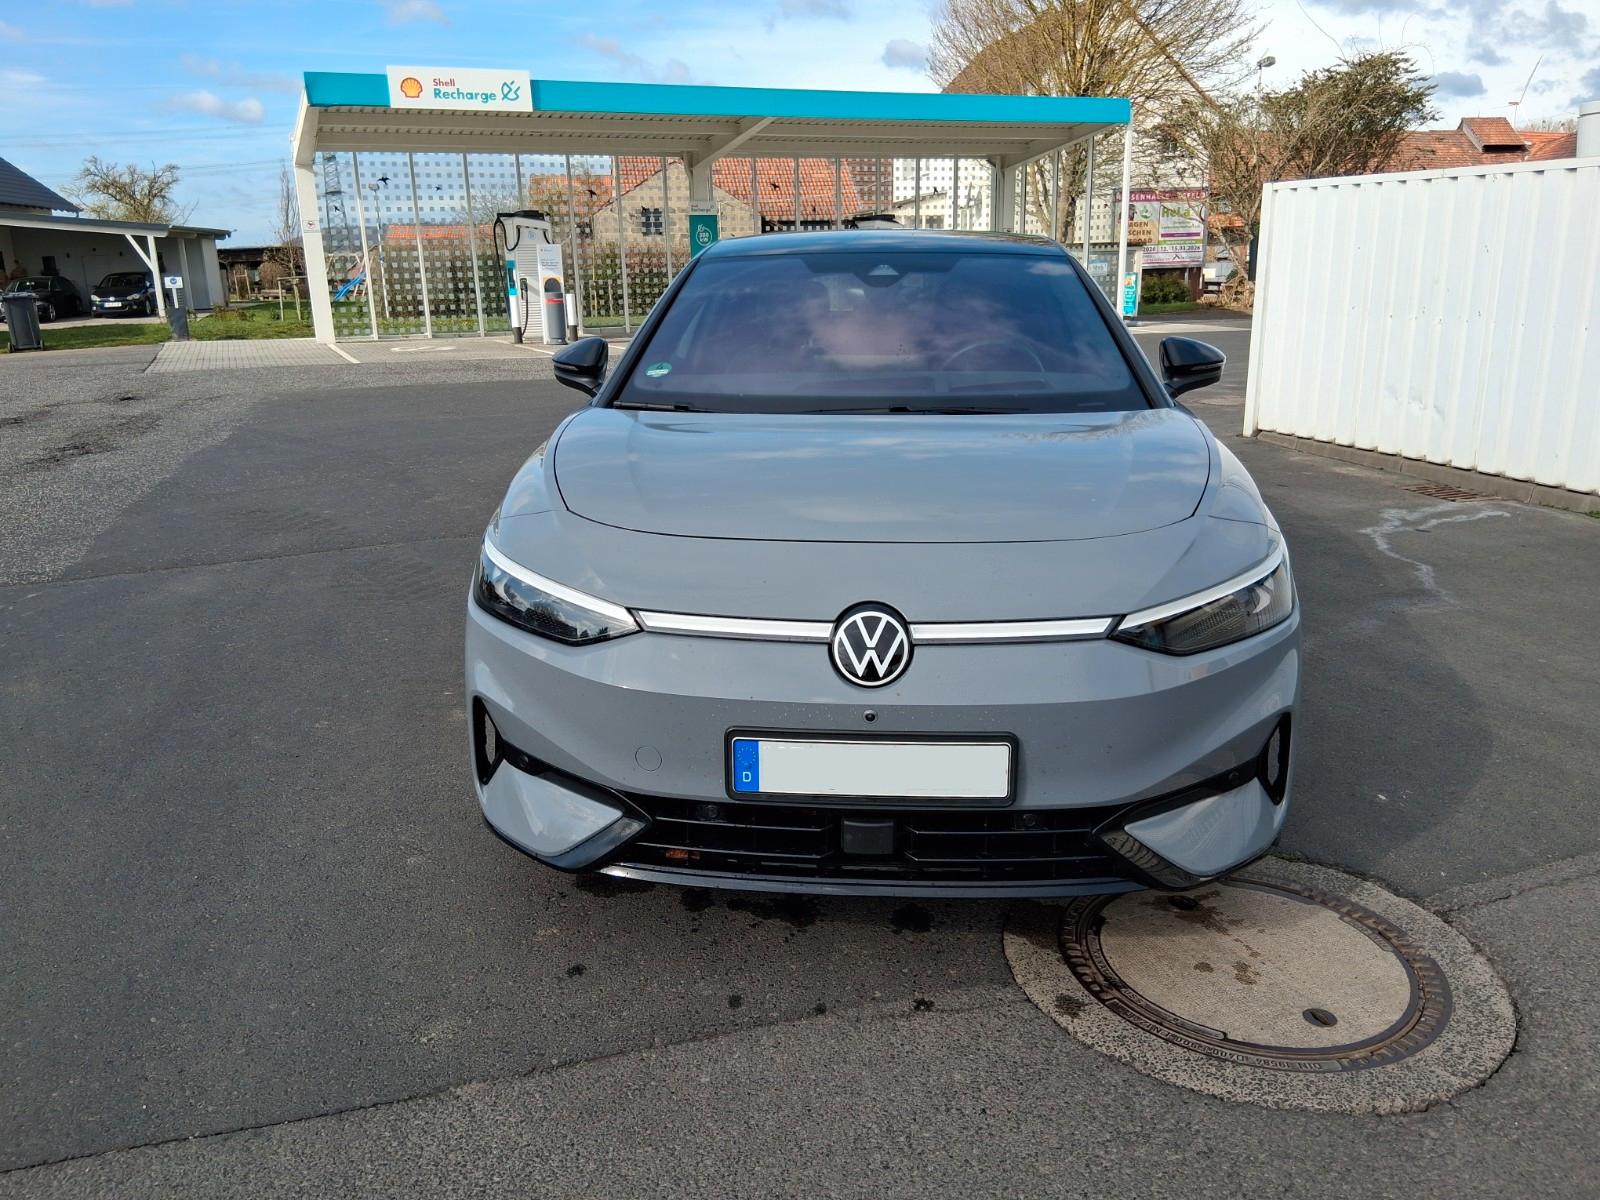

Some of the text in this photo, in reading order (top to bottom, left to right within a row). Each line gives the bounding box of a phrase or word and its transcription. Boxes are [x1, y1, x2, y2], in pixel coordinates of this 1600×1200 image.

[433, 78, 456, 87] Shell
[433, 88, 497, 103] Recharge
[837, 614, 906, 681] VW
[742, 771, 752, 783] D
